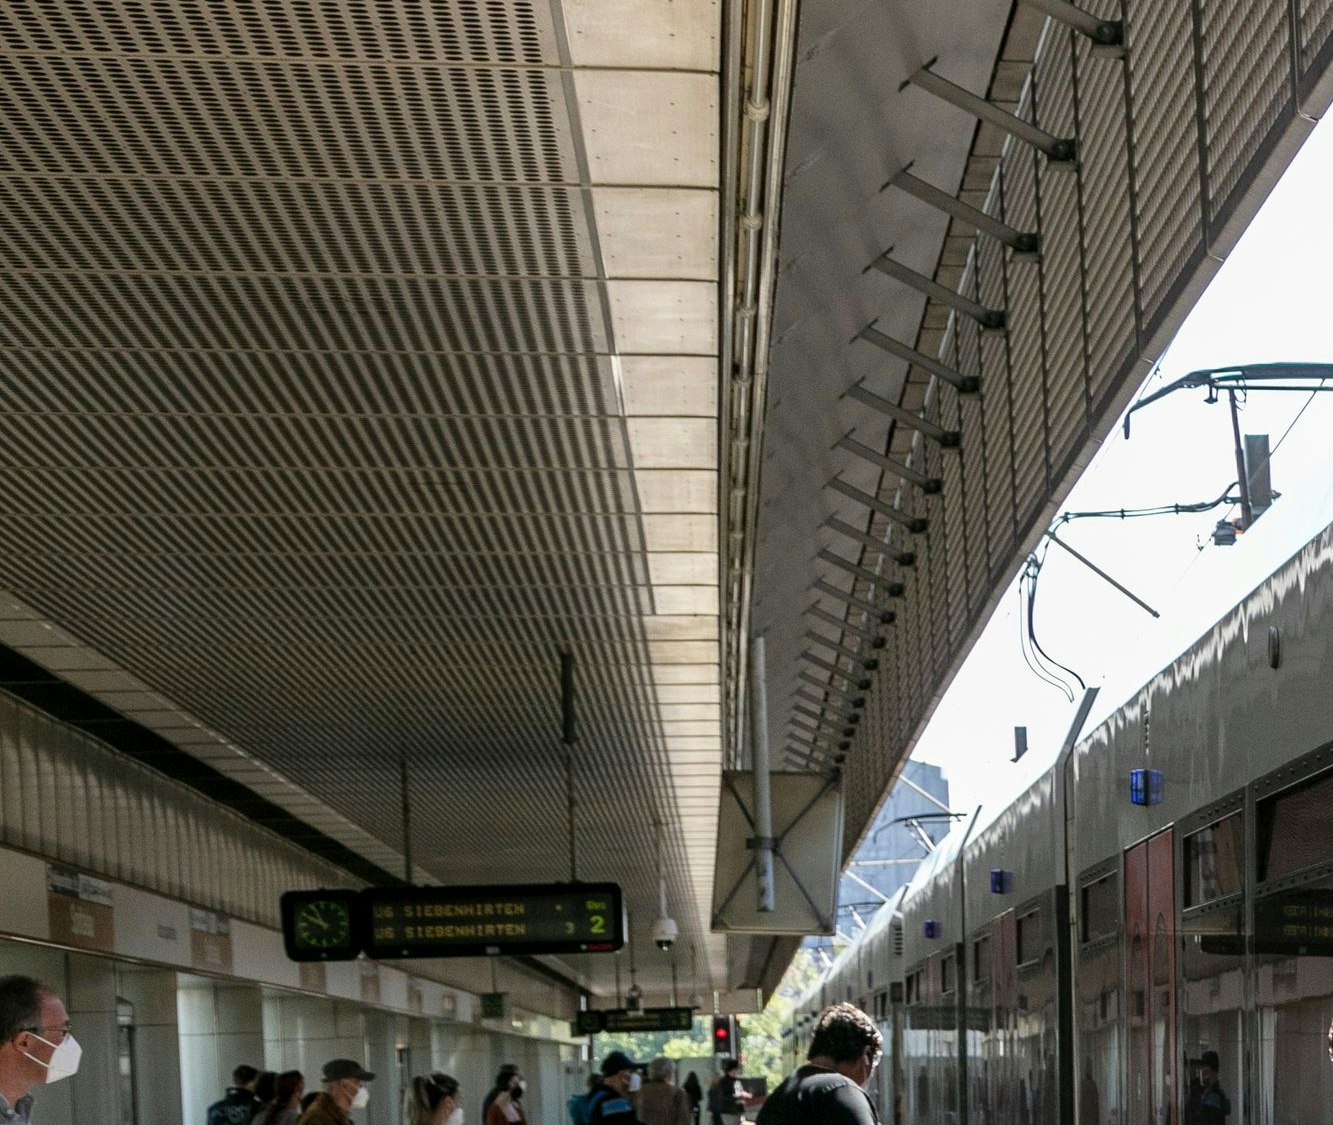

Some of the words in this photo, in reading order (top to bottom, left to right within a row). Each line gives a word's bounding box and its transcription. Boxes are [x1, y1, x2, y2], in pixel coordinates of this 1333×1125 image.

[403, 903, 525, 918] SIEBENHIRTEN
[404, 923, 527, 939] SIEBENHIRTEN
[590, 914, 606, 934] 2
